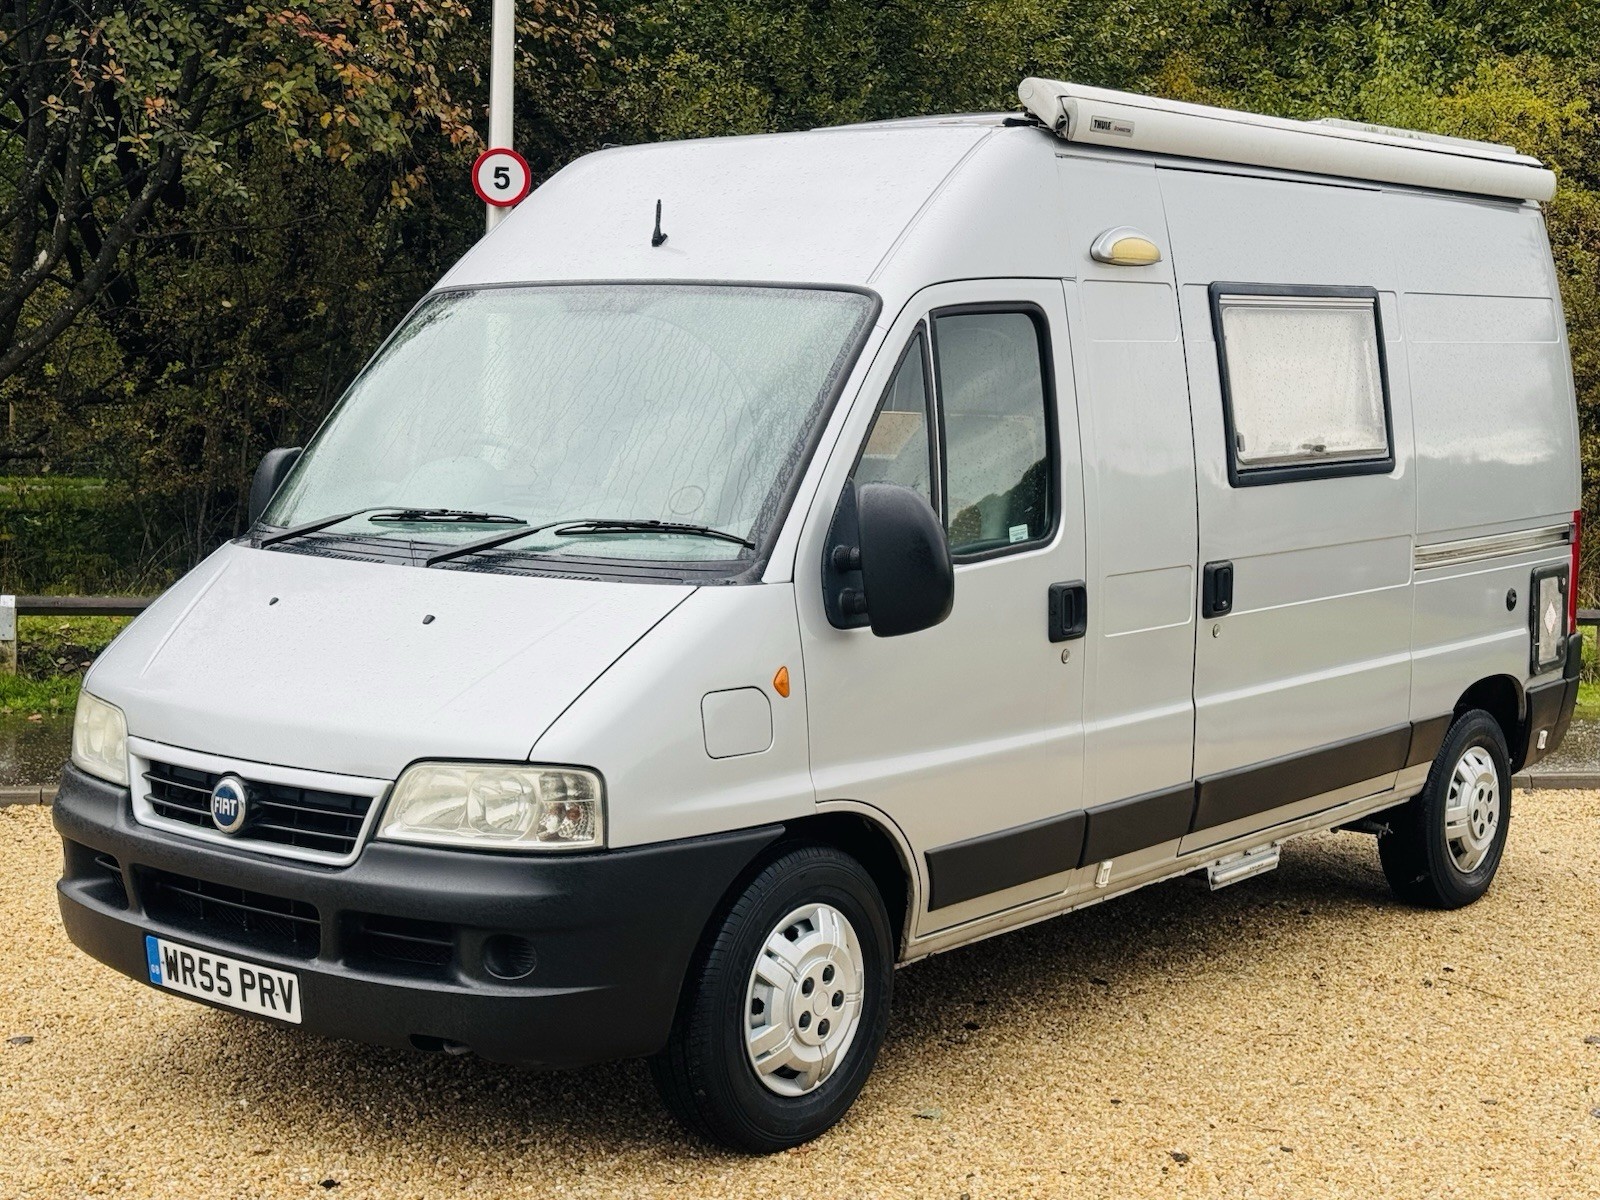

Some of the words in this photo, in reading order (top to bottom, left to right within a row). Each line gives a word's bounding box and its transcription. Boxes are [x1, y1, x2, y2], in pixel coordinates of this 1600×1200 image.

[1094, 119, 1111, 130] THULE
[494, 166, 510, 190] 5
[214, 796, 237, 816] FIAT
[163, 946, 232, 998] WR55
[239, 967, 293, 1014] PRV
